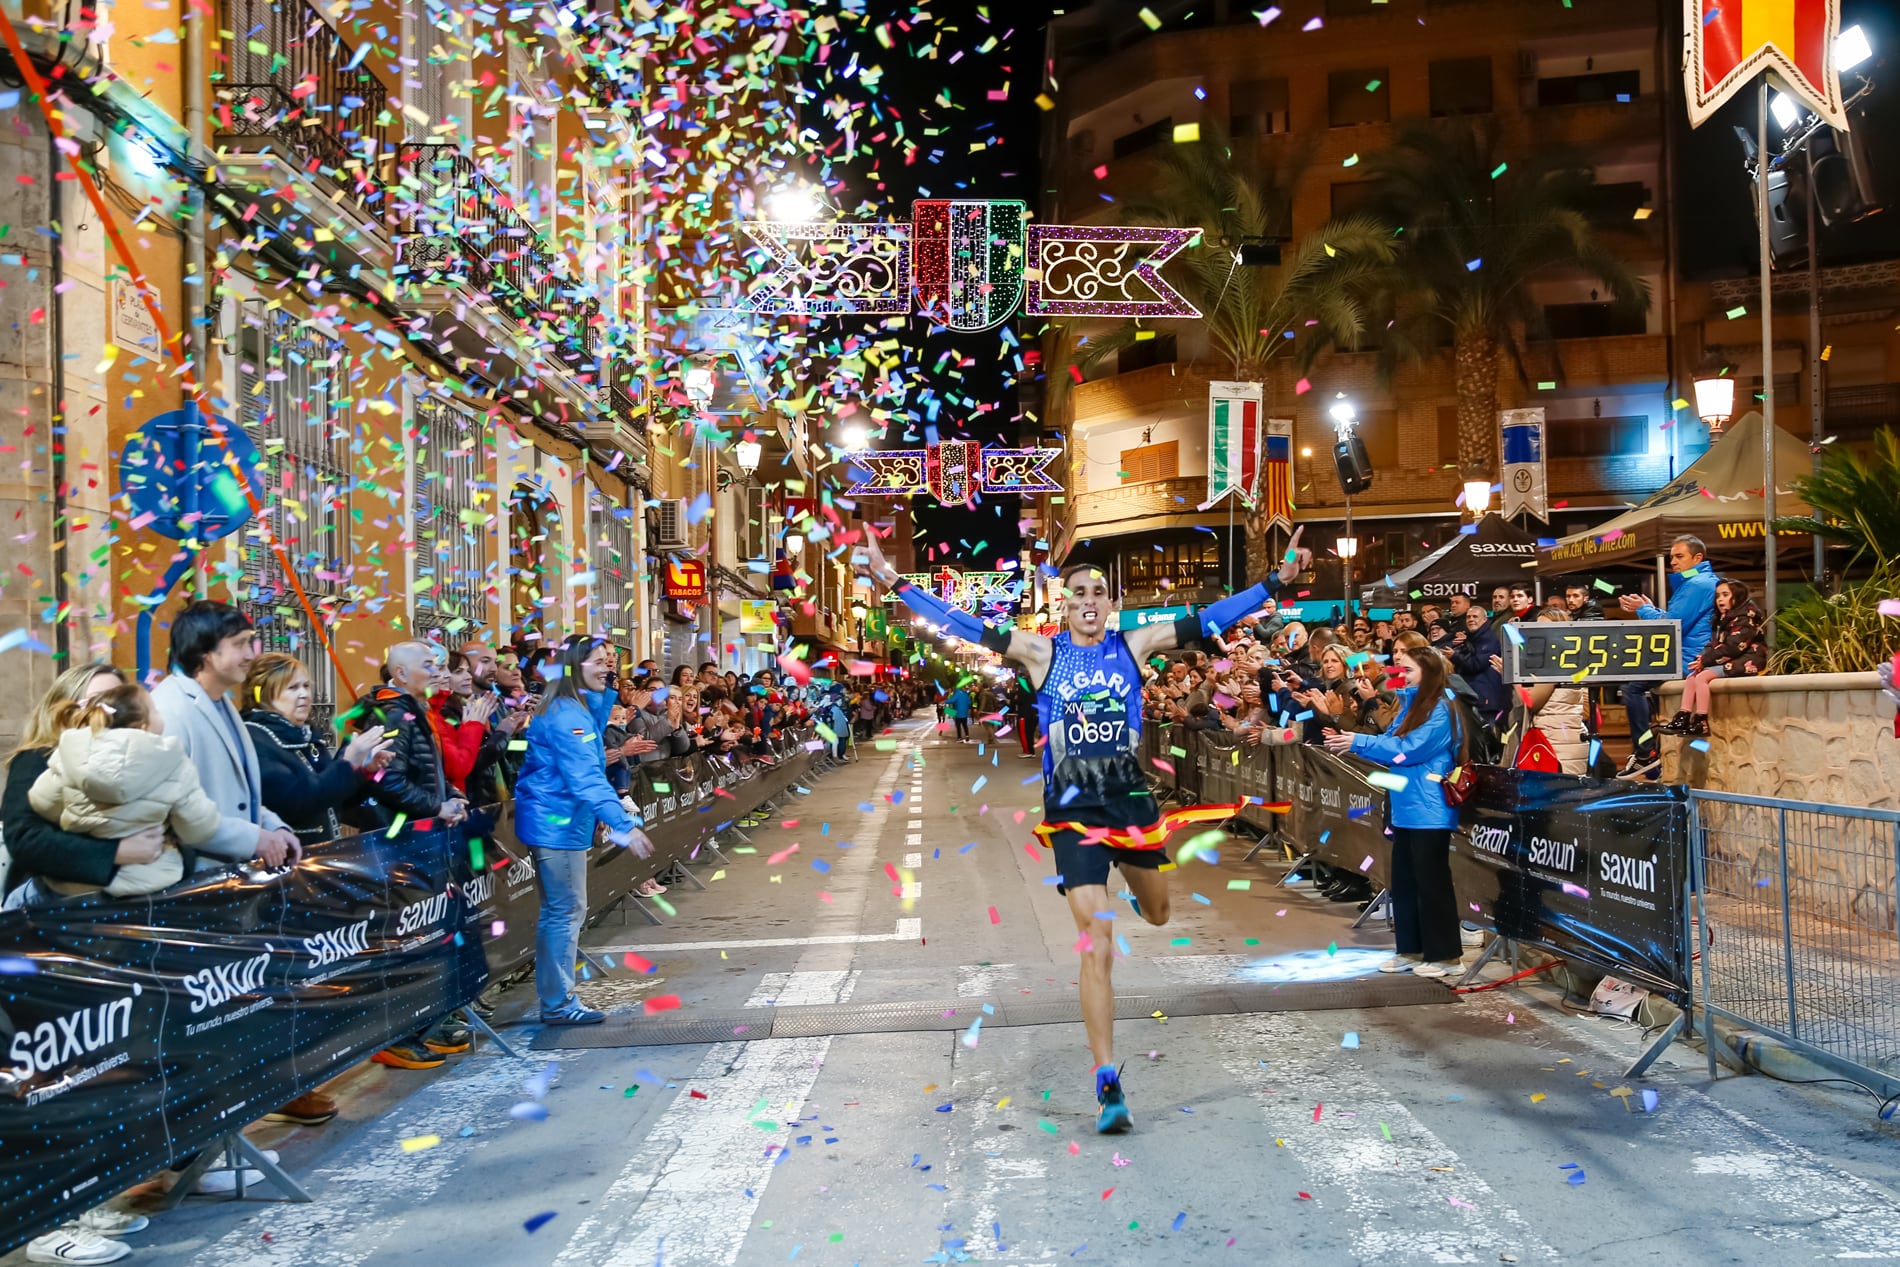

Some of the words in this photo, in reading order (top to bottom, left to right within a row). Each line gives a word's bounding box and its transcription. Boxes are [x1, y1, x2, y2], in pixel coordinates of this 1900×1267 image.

[1469, 542, 1536, 554] saxun
[1423, 580, 1480, 597] saxun
[1068, 720, 1125, 744] 0697
[1469, 824, 1513, 855] saxun
[1528, 837, 1578, 872] saxun
[1600, 851, 1657, 893] saxun
[396, 882, 450, 936] saxun
[303, 909, 375, 969] saxun
[183, 943, 274, 1014] saxun
[10, 982, 142, 1080] saxun
